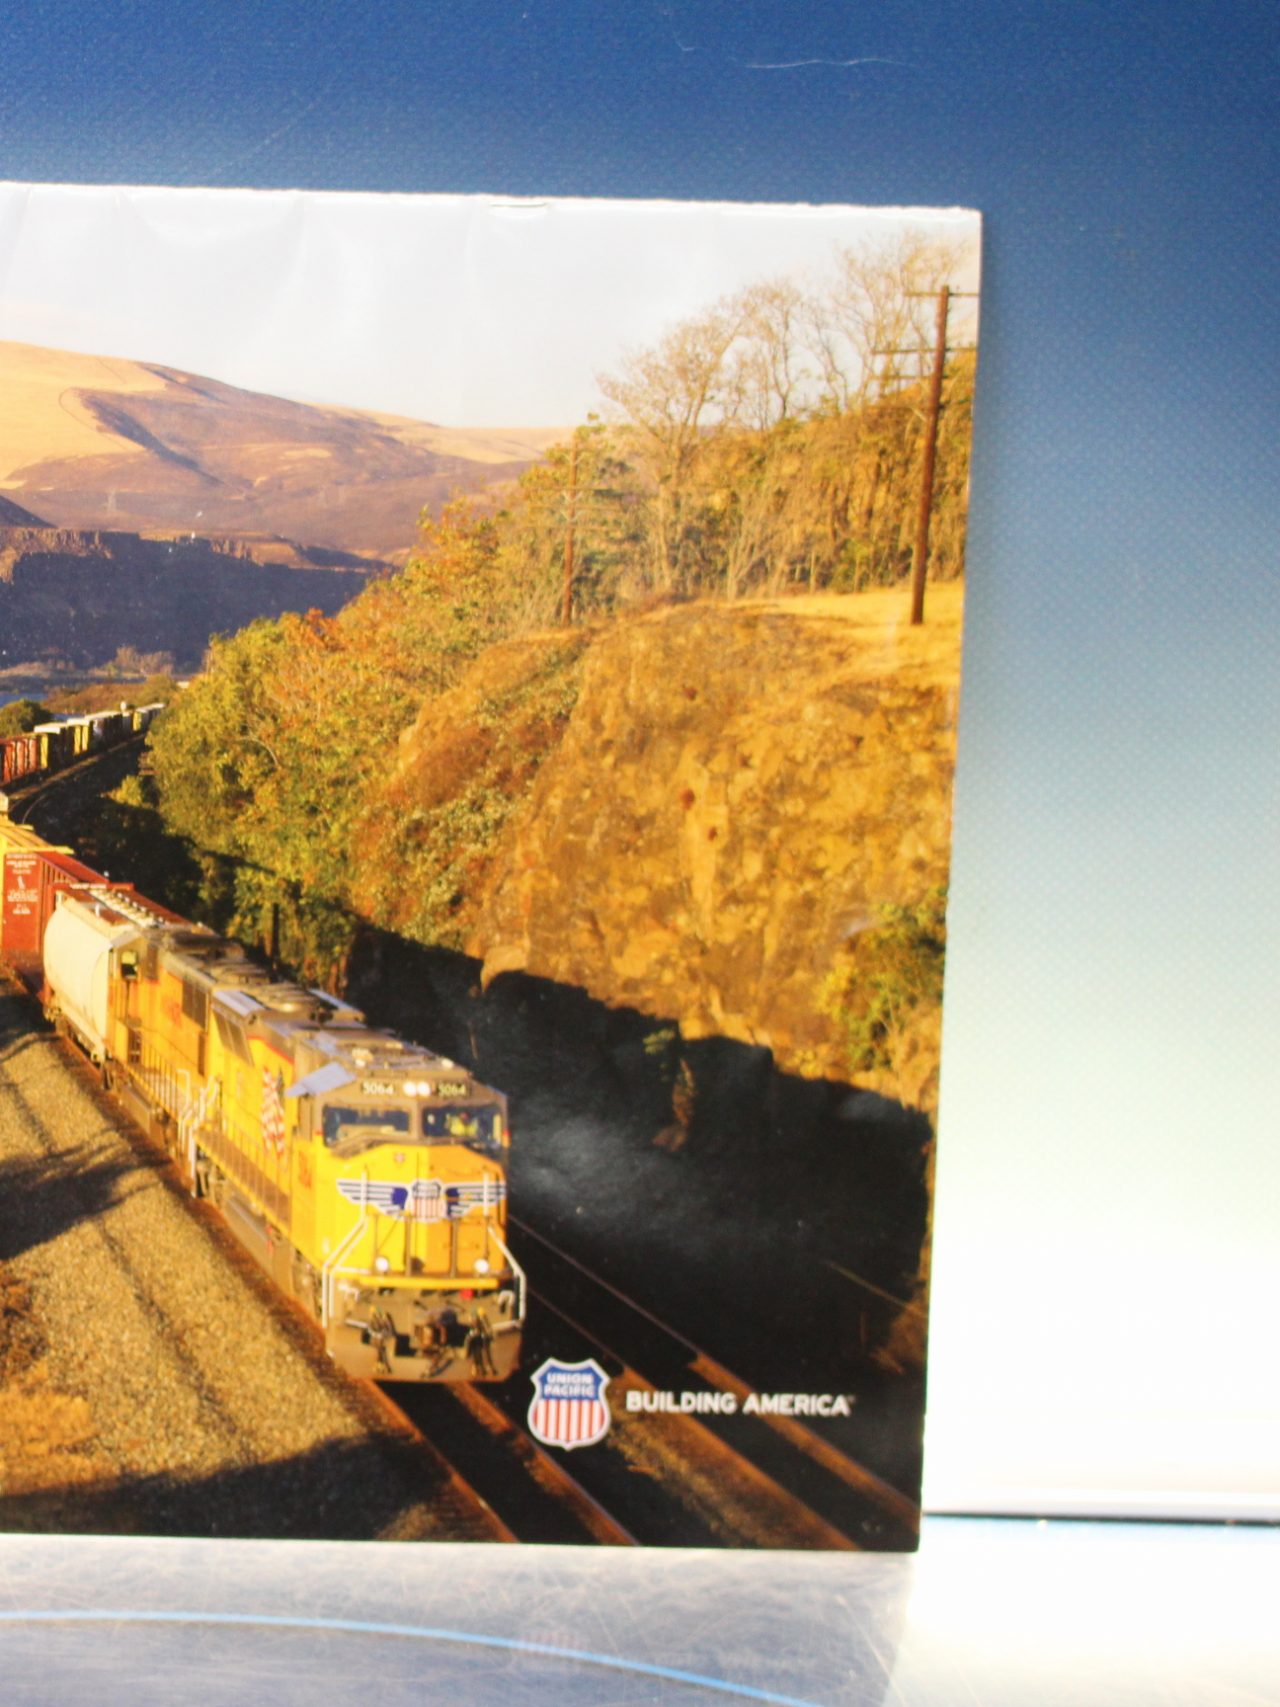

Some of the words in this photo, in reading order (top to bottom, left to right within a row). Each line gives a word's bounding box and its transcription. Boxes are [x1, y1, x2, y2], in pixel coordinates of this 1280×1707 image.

[546, 1372, 594, 1385] UNION
[543, 1383, 595, 1398] PACIFIC
[625, 1390, 736, 1414] BUILDING
[742, 1393, 851, 1416] AMERICA
